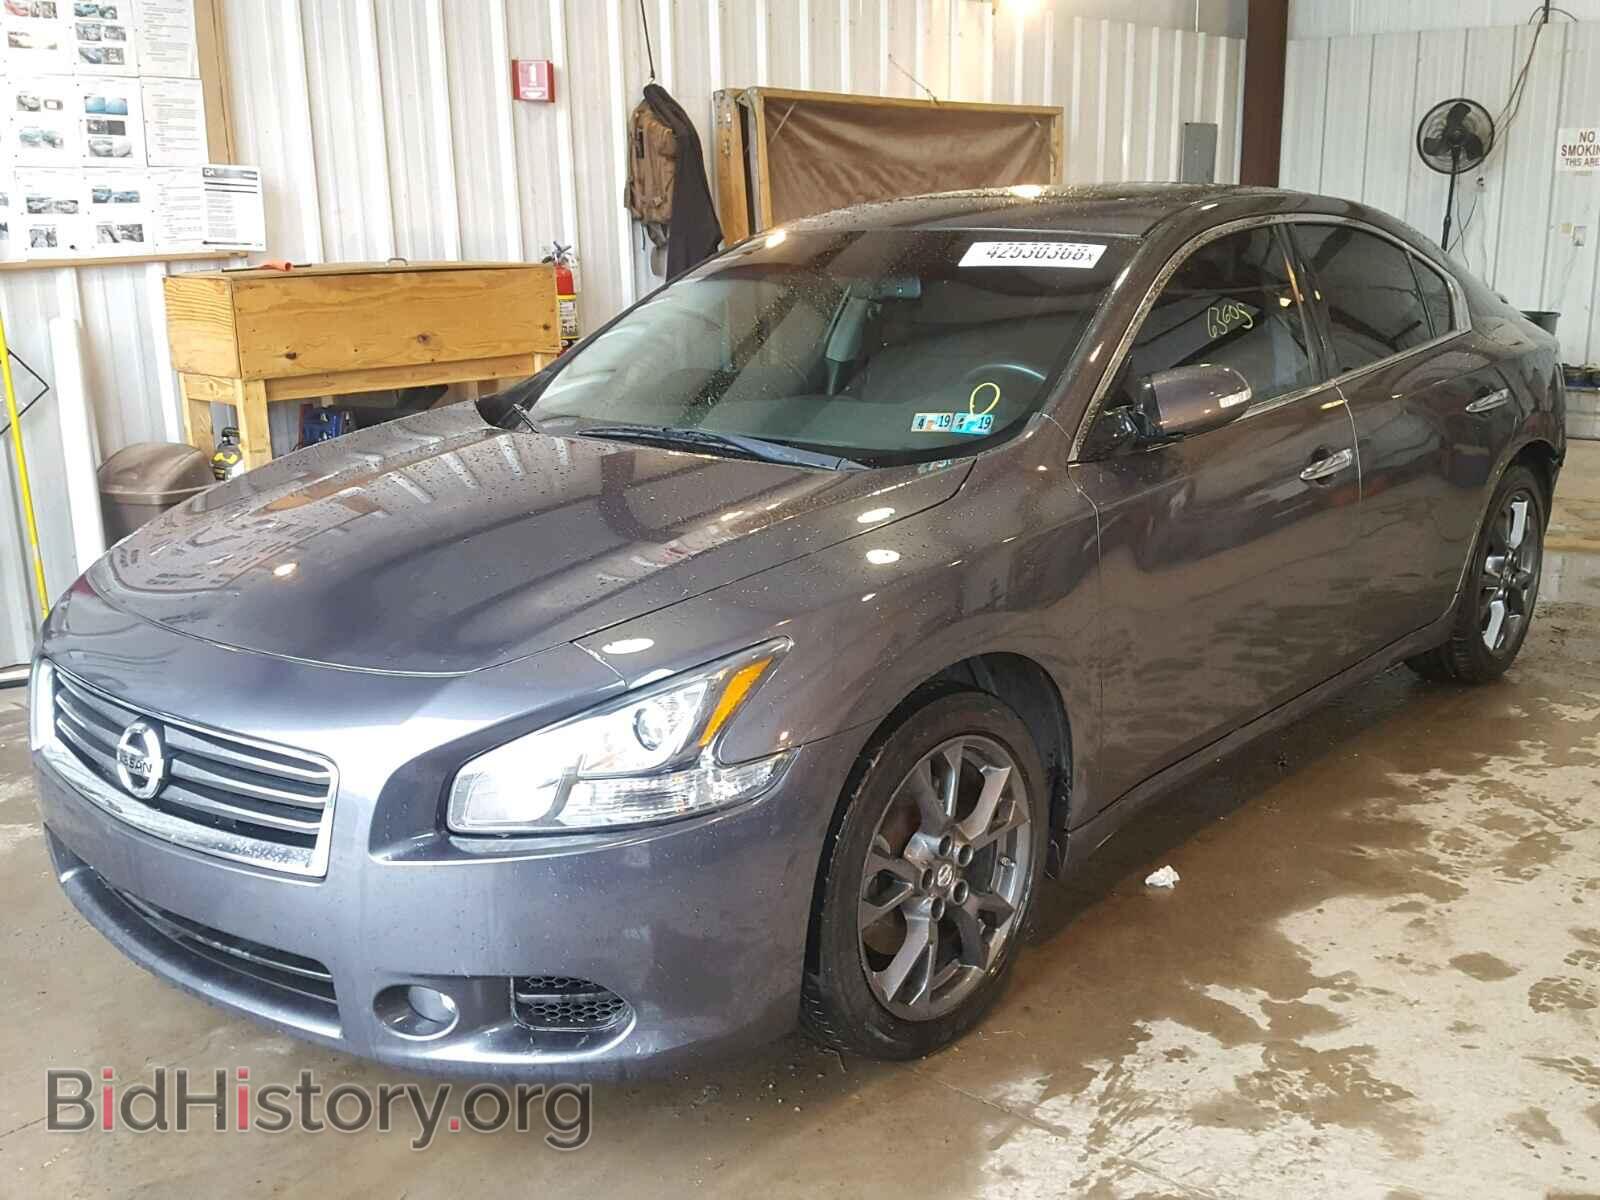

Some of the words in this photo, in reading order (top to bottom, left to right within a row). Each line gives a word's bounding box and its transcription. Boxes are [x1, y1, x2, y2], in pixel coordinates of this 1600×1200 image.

[1579, 131, 1595, 143] NO
[1565, 158, 1582, 167] THIS
[938, 415, 951, 428] 19
[977, 416, 992, 430] 19
[119, 753, 152, 773] SSAN
